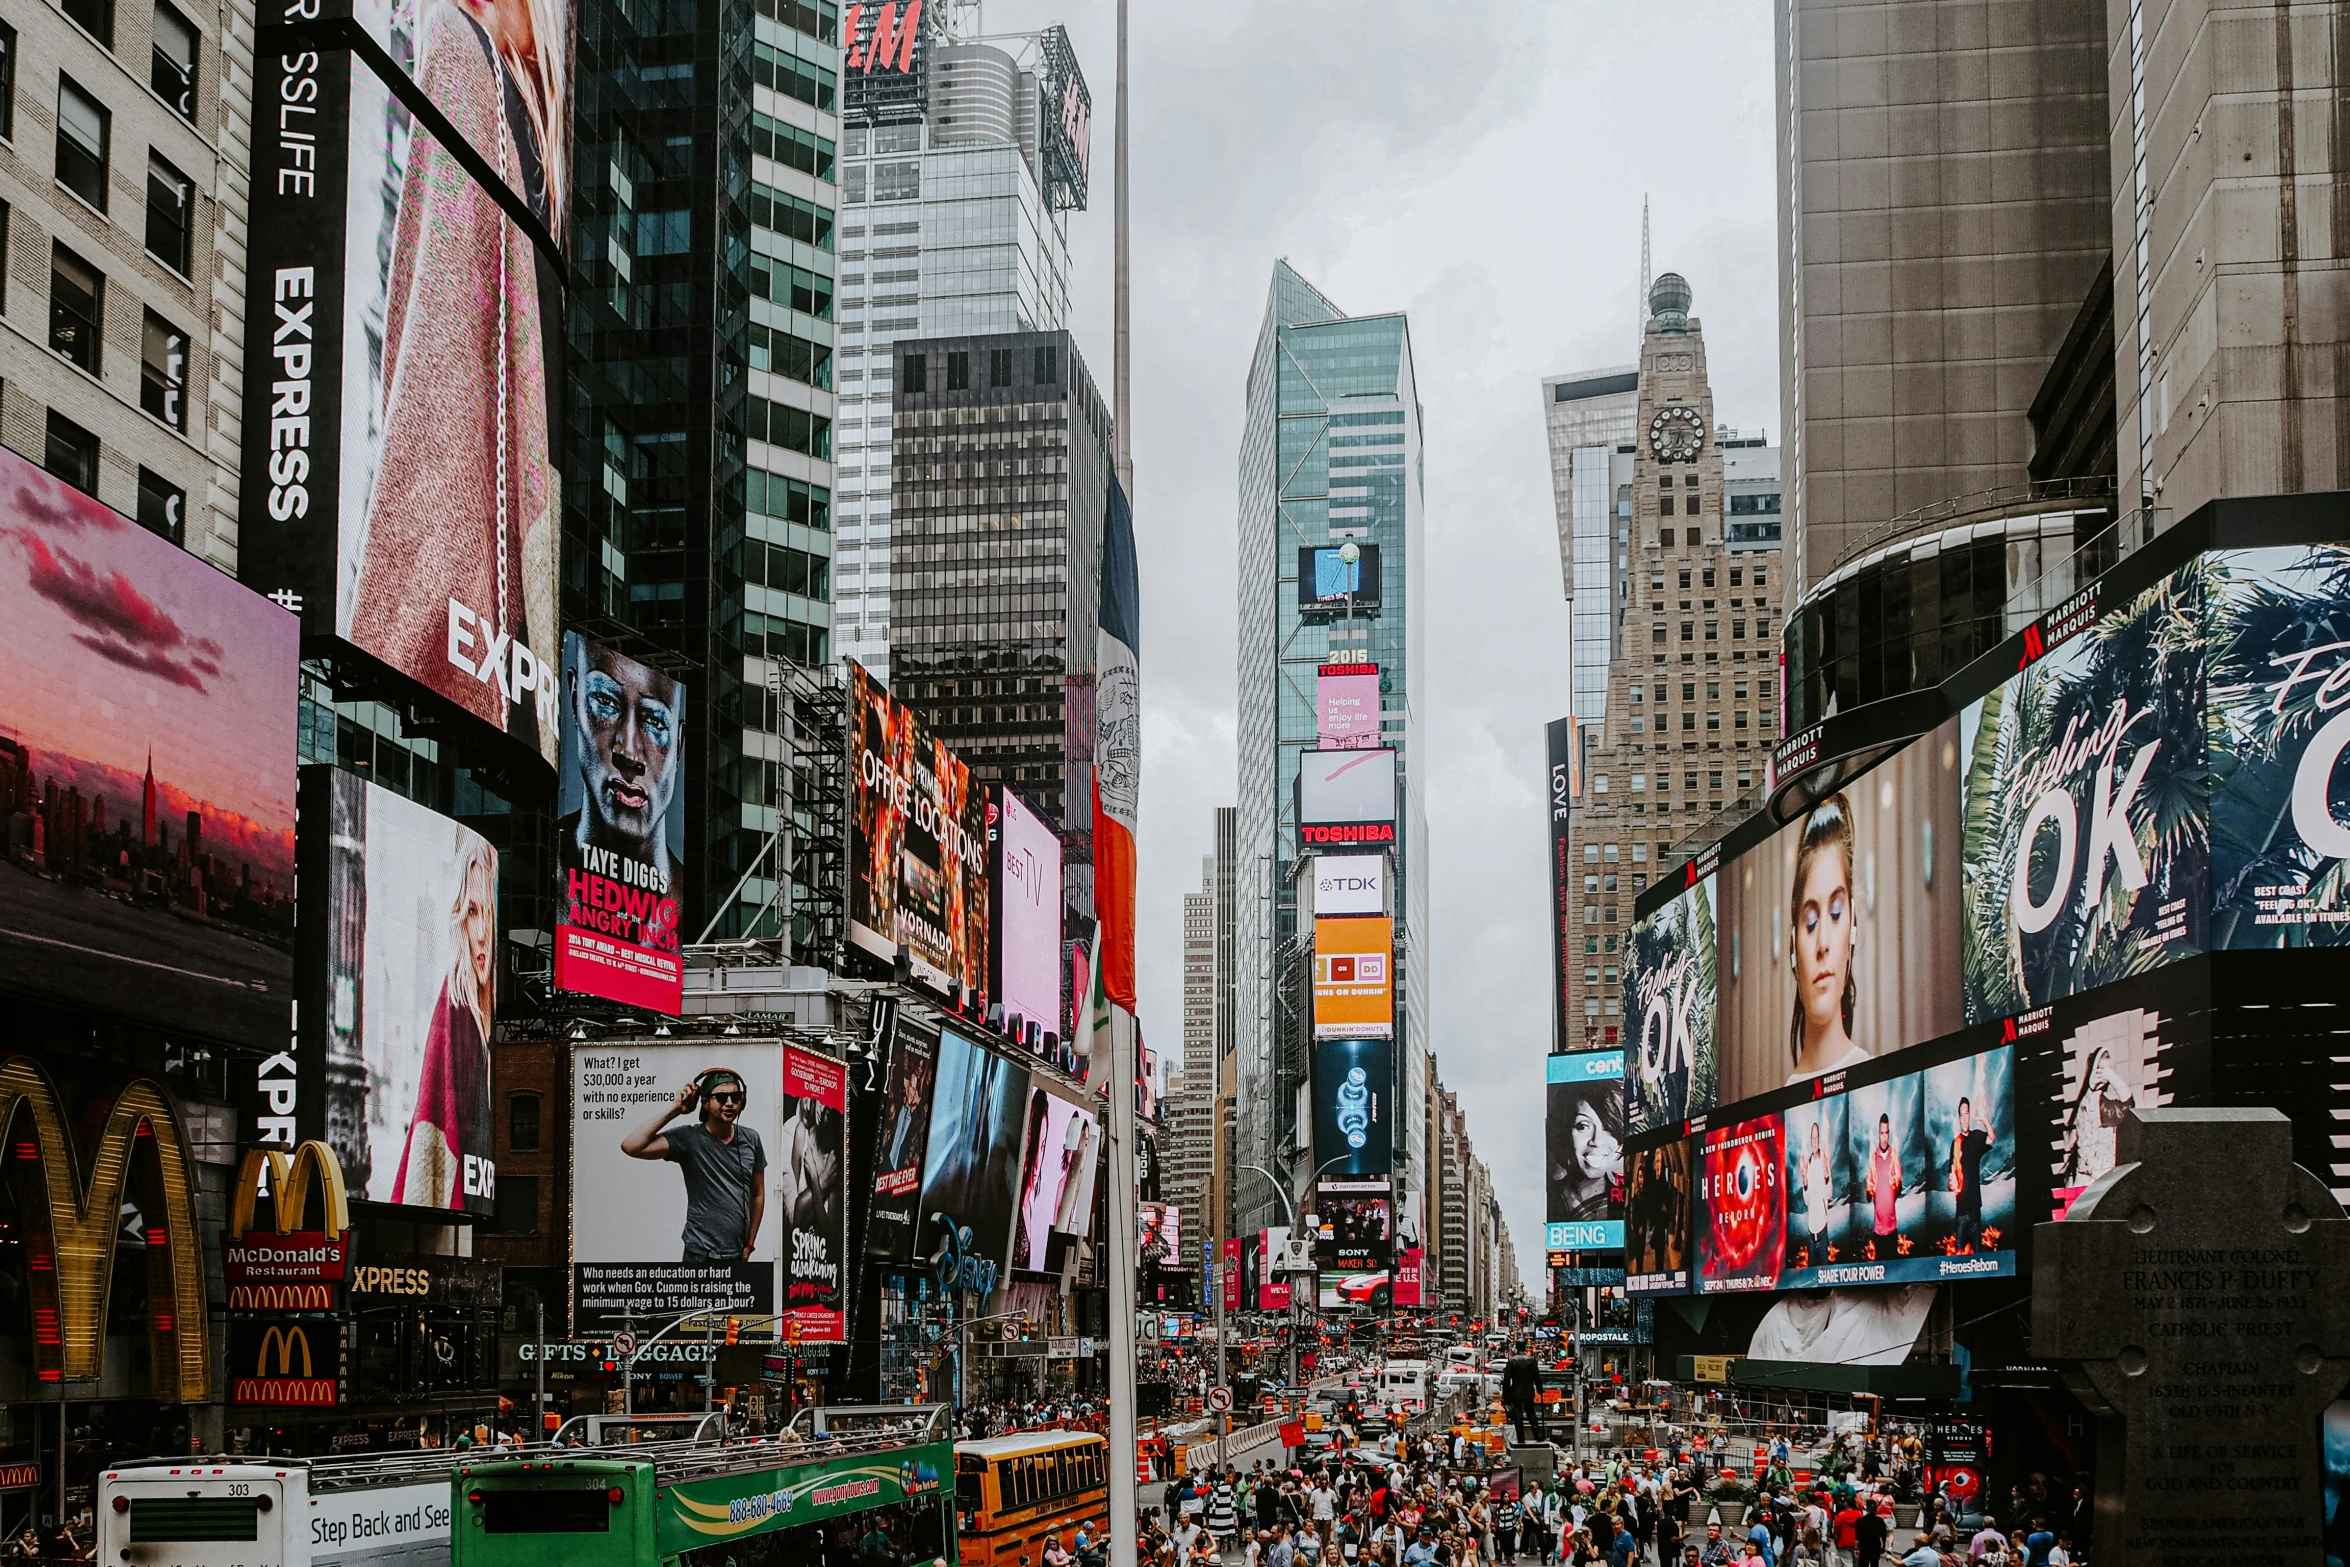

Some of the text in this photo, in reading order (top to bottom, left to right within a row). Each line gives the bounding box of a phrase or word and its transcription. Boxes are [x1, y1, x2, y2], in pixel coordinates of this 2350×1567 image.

[268, 266, 315, 522] EXPRESS
[2046, 581, 2103, 629] MARRIOTT
[2047, 606, 2096, 646] MARQUIS
[1329, 650, 1367, 664] 2015
[1319, 664, 1377, 676] TOSHIBA
[1328, 698, 1360, 706] Helping
[1328, 713, 1367, 723] enjoy life
[1777, 725, 1824, 762] MARRIOTT
[1777, 746, 1817, 779] MARQUIS
[2003, 699, 2152, 812] Feeling
[1552, 763, 1568, 822] LOVE
[862, 749, 983, 875] OFFICE LOCATIONS
[1302, 825, 1394, 842] TOSHIBA
[2014, 738, 2161, 933] OK
[1697, 842, 1721, 865] MARRIOTT
[581, 843, 667, 894] TAYE DIGGS
[1697, 858, 1719, 877] MARQUIS
[1007, 847, 1042, 906] BEST TV
[1333, 877, 1376, 891] TDK
[2255, 884, 2308, 896] BEST COAST
[568, 867, 679, 930] HEDWIG
[2159, 898, 2186, 917] BEST COAST
[617, 911, 641, 924] and the
[2255, 912, 2350, 925] AVAILABLE ON ITUNES
[568, 903, 678, 951] ANGRY INCH
[899, 904, 953, 956] VORNADO
[596, 939, 634, 961] AWARD BEST
[1637, 948, 1694, 1007] Feeling
[747, 1012, 787, 1021] LAMAR
[2018, 1006, 2053, 1025] MARRIOTT
[1642, 978, 1697, 1084] OK
[2018, 1020, 2050, 1037] MARQUIS
[584, 1056, 640, 1071] What? I get
[583, 1073, 656, 1088] $30,000 a year
[1823, 1071, 1846, 1084] MARRIOTT
[1823, 1081, 1845, 1094] MARQUIS
[583, 1090, 675, 1105] with no experience
[583, 1107, 625, 1120] or skills?
[1718, 1129, 1775, 1151] PHENOMENON BEGINS
[875, 1176, 889, 1192] BEST
[889, 1171, 902, 1189] TIME
[902, 1167, 917, 1185] EVER
[1701, 1162, 1775, 1200] HEROES
[1719, 1208, 1755, 1224] REBORN
[1550, 1226, 1605, 1246] BEING
[228, 1247, 340, 1263] McDonald's
[2134, 1249, 2304, 1265] LIEUTENANT COLONEL
[246, 1266, 321, 1276] Restaurant
[790, 1250, 838, 1288] awakening
[930, 1212, 998, 1318] Disney
[1338, 1259, 1362, 1268] MAKER
[1939, 1258, 1998, 1276] #HeroesReborn
[583, 1266, 731, 1278] Who needs an education or hard
[1818, 1265, 1885, 1283] SHARE YOUR POWER
[351, 1266, 430, 1295] XPRESS
[583, 1281, 751, 1295] work when Gov. Cuomo is raising the
[2122, 1270, 2319, 1291] FRANCIS DUFFY
[583, 1296, 755, 1310] minimum wage to 15 dollars an hour?
[2134, 1296, 2252, 1309] MAY JUNE
[1568, 1333, 1629, 1341] AROPOSTALE
[2148, 1322, 2294, 1337] CATHOLIC PRIEST
[518, 1344, 717, 1362] GFTS LGGAGE
[551, 1372, 574, 1380] Nikon
[2183, 1362, 2261, 1376] CHAPLAIN
[2169, 1405, 2200, 1418] OLD
[1937, 1424, 1983, 1435] HEROES
[332, 1433, 370, 1447] EXPRESS
[2169, 1445, 2297, 1459] LIFE OF SERVICE
[2209, 1462, 2236, 1473] FOR
[228, 1484, 249, 1496] 303
[585, 1478, 606, 1490] 304
[2145, 1477, 2302, 1490] GOD AND COUNTRY
[812, 1477, 879, 1507] www.gonytours.com
[729, 1490, 793, 1525] 888-680-4669
[312, 1505, 449, 1547] Step Back and See
[2199, 1518, 2271, 1530] AMERICAN
[2161, 1537, 2196, 1549] YORK
